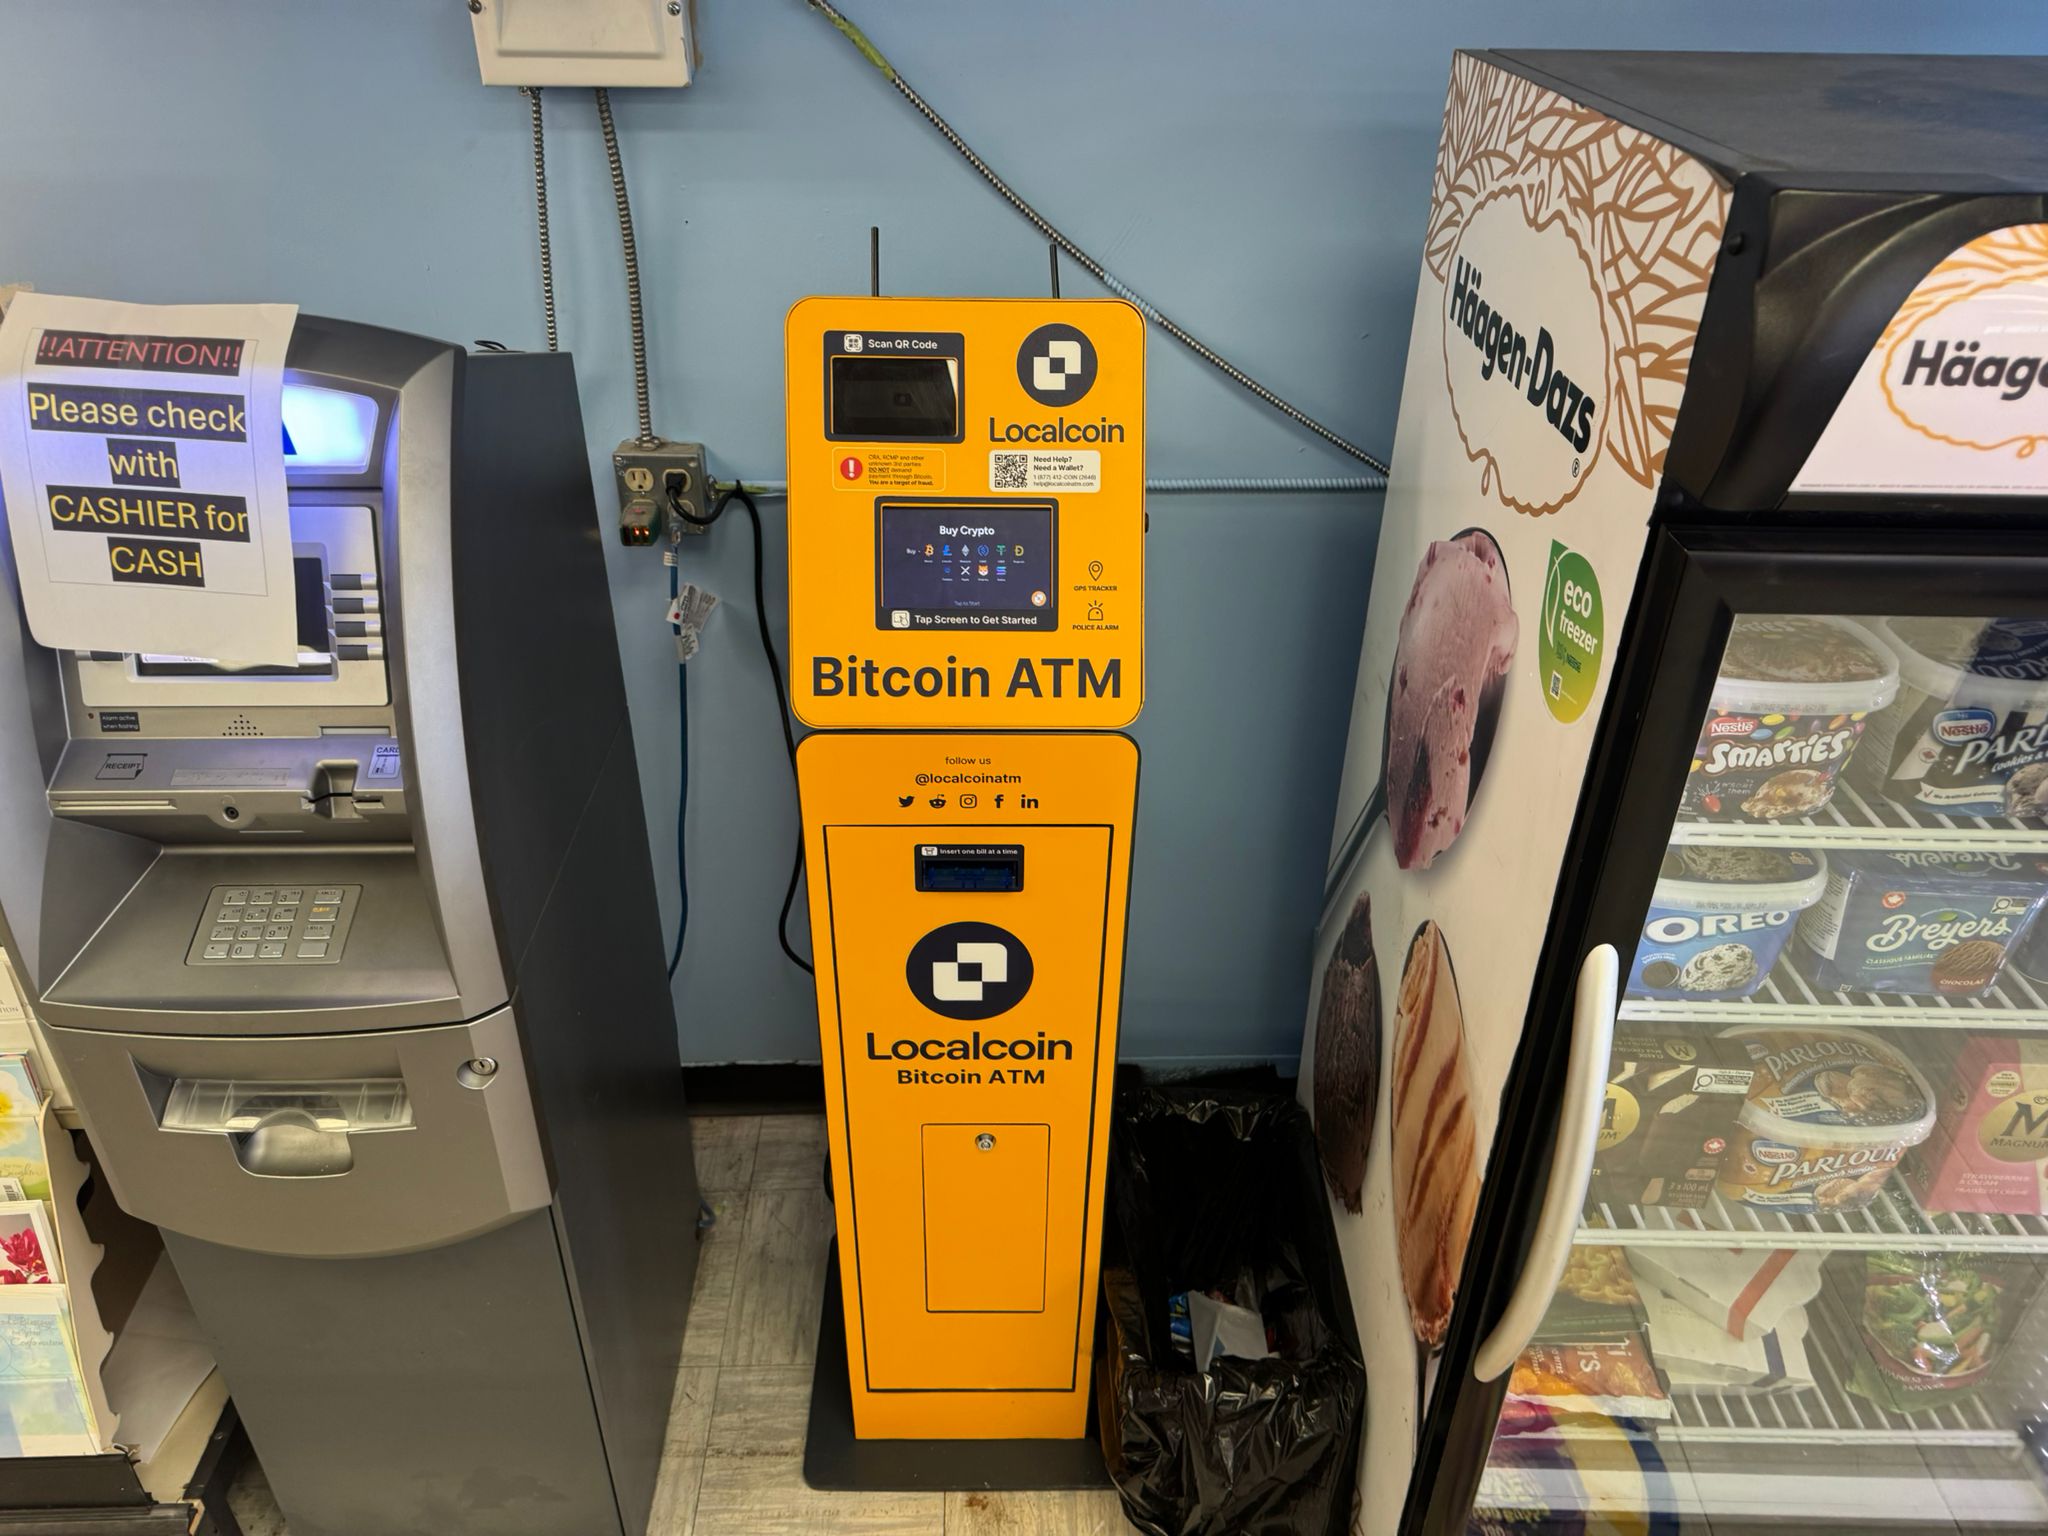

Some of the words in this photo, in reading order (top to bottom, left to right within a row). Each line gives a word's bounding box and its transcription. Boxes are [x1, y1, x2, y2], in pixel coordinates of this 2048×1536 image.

[37, 335, 242, 369] !!ATTENTION!!
[868, 339, 891, 350] Scan
[895, 339, 910, 350] QR
[911, 339, 938, 350] Code
[1450, 254, 1596, 454] Häagen-Dazs
[29, 391, 138, 426] Please
[147, 400, 246, 433] check
[989, 416, 1125, 444] Localcoin
[109, 448, 179, 480] with
[1053, 456, 1073, 464] Help?
[50, 493, 200, 530] CASHIER
[204, 504, 248, 533] for
[939, 525, 958, 538] Buy
[960, 525, 996, 538] Crypto
[111, 545, 203, 579] CASH
[1563, 579, 1593, 619] eco
[914, 614, 932, 625] Tap
[934, 615, 967, 625] Screen
[970, 616, 981, 625] to
[982, 616, 999, 625] Get
[1001, 616, 1038, 625] Started
[1559, 609, 1598, 656] freezer
[811, 654, 991, 698] Bitcoin
[1005, 657, 1122, 699] ATM
[1711, 721, 1755, 734] Nestlé
[1941, 723, 1989, 737] Nestlé
[105, 762, 142, 770] RECEIPT
[945, 756, 977, 766] follow
[979, 758, 992, 766] us
[1991, 752, 2034, 774] Cookies
[915, 772, 1022, 786] @localcoinatm
[280, 894, 288, 903] 3
[274, 912, 282, 921] 6
[268, 929, 276, 938] 9
[1645, 910, 1791, 944] OREO
[1866, 913, 2012, 953] Breyers
[234, 946, 243, 955] 0
[1940, 978, 1985, 986] CHOCOLAT
[866, 1031, 1073, 1061] Localcoin
[1764, 1040, 1875, 1082] PARLOUR
[897, 1068, 982, 1085] Bitcoin
[988, 1069, 1045, 1085] ATM
[1758, 1150, 1797, 1160] Nestlé
[1768, 1147, 1901, 1186] PARLOUR
[1682, 1183, 1697, 1191] 100
